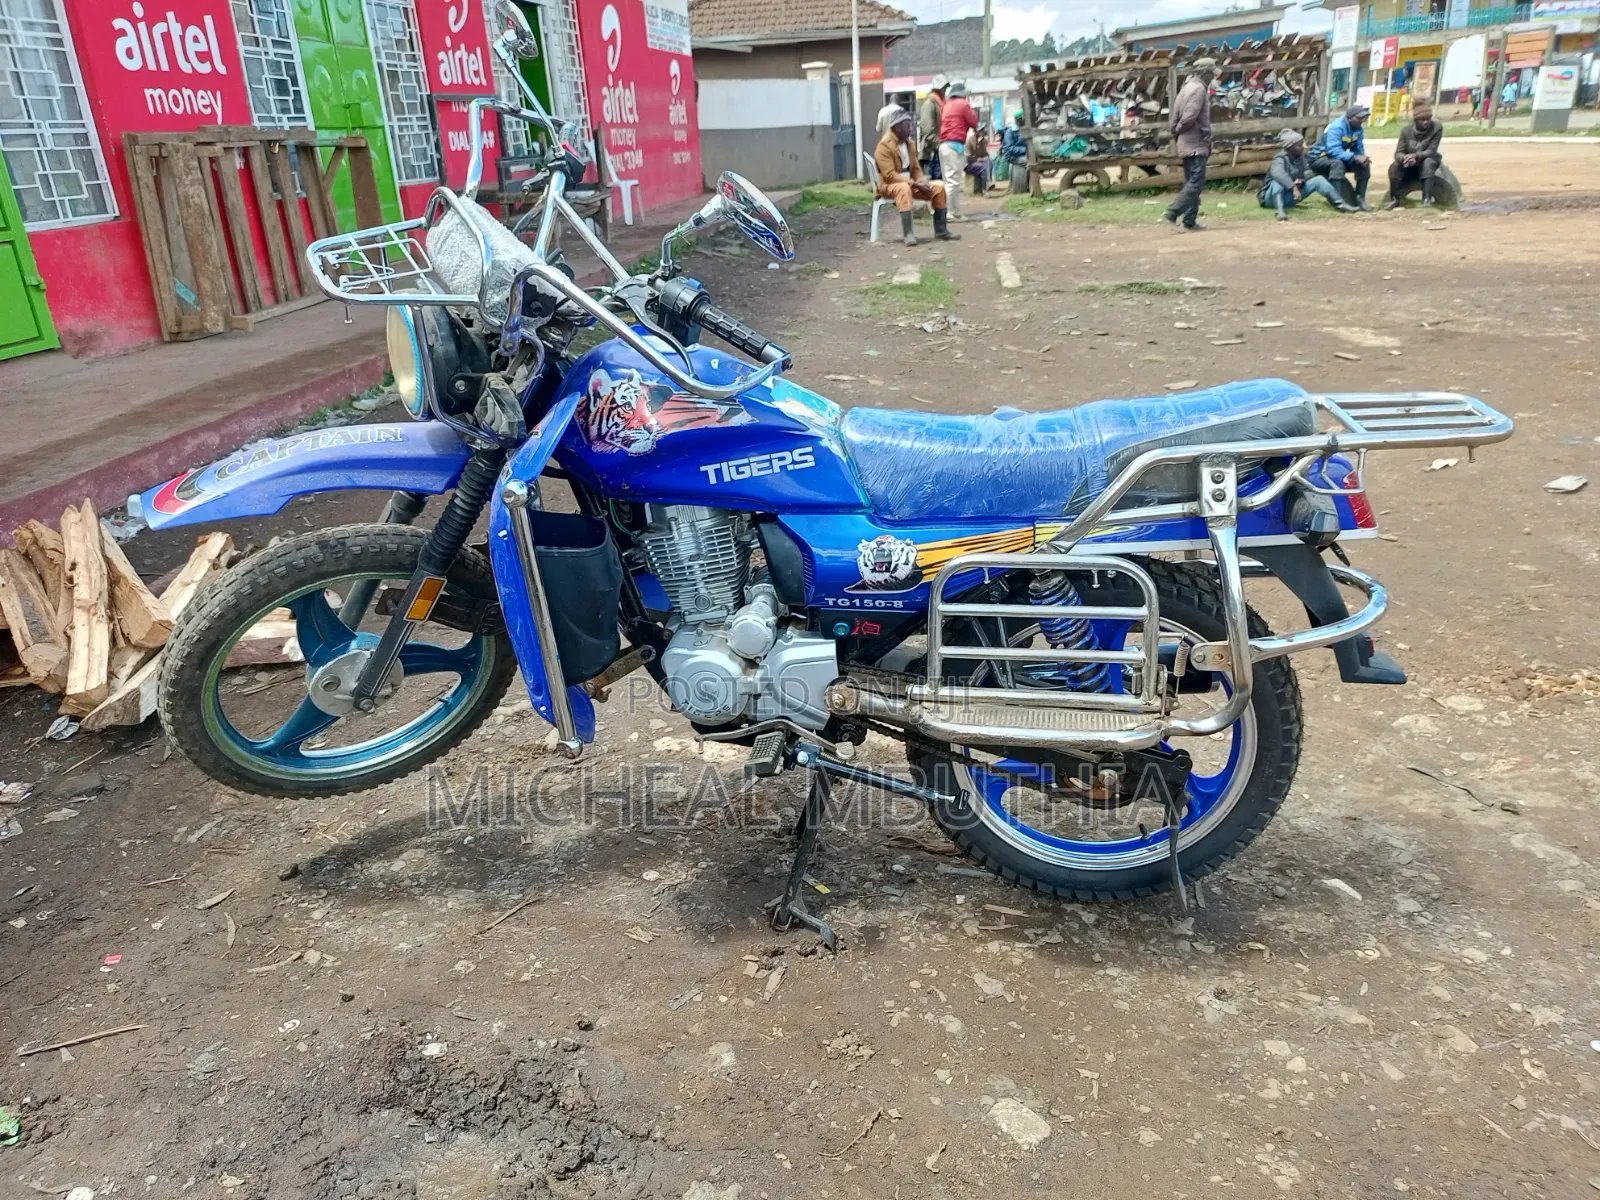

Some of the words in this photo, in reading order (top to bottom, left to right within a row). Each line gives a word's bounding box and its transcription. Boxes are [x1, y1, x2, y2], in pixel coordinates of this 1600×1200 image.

[112, 1, 227, 75] airtel
[437, 36, 487, 87] airtel
[144, 86, 223, 125] money
[601, 74, 639, 124] airtel
[448, 130, 470, 151] DIAL
[610, 127, 636, 149] money
[215, 427, 402, 482] CAPTAIN
[700, 446, 816, 485] TIGERS
[824, 597, 904, 609] TG150-8
